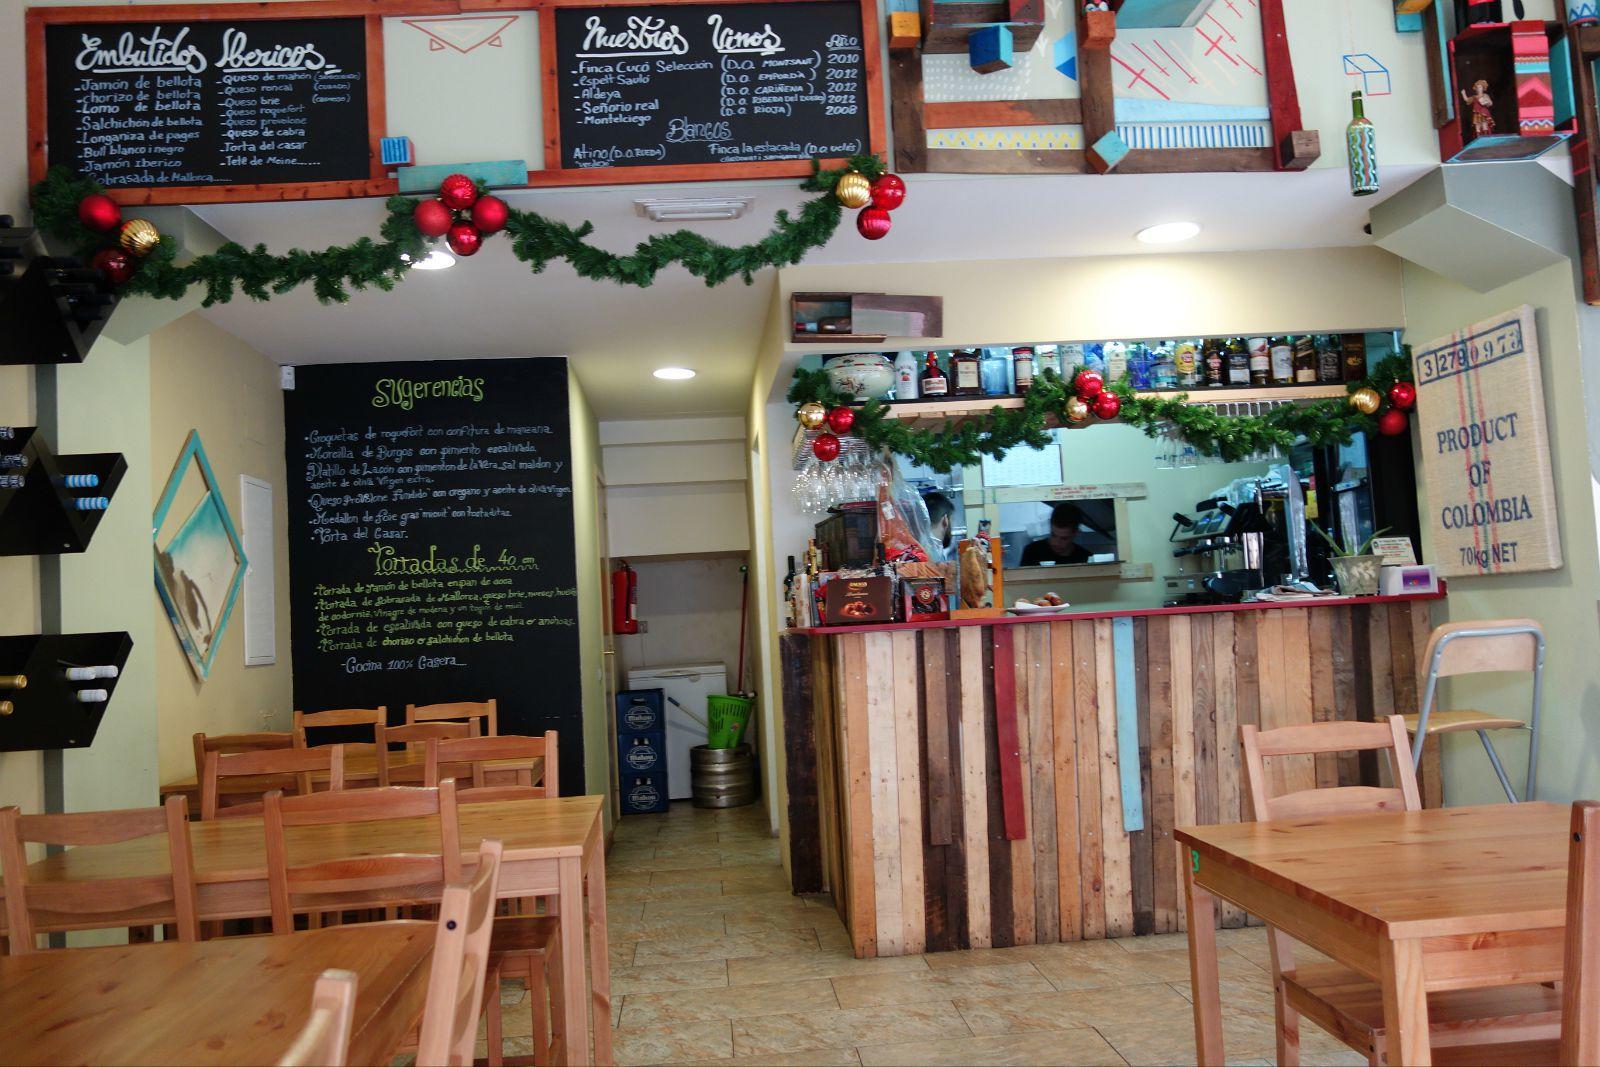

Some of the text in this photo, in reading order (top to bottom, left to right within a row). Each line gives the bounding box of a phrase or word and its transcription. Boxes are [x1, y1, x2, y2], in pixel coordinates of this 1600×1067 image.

[582, 14, 858, 55] Nuestros Vinos Año
[75, 26, 207, 74] Embutidos
[578, 60, 614, 74] Finca
[827, 53, 860, 64] 2010
[222, 75, 259, 86] Queso
[262, 72, 275, 81] de
[825, 68, 858, 79] 2012
[135, 75, 150, 89] de
[156, 75, 202, 88] bellota
[261, 83, 294, 92] roncal
[136, 90, 149, 101] de
[156, 89, 201, 100] bellota
[581, 88, 622, 103] Aldeya
[827, 82, 858, 93] 2012
[82, 100, 201, 114] Lomo de bellota
[225, 96, 280, 109] Queso brie
[635, 98, 660, 111] real
[827, 94, 857, 104] 2012
[825, 105, 858, 116] 2008
[151, 116, 164, 127] de
[167, 116, 203, 127] bellota
[82, 131, 145, 146] Longaniza
[149, 130, 164, 141] de
[262, 127, 275, 137] de
[277, 127, 306, 137] cabra
[83, 146, 106, 158] Bull
[109, 144, 146, 156] blanco
[154, 146, 185, 156] negro
[224, 141, 308, 152] Torta del casar
[708, 142, 740, 155] Finca
[742, 142, 753, 153] la
[250, 156, 263, 166] de
[364, 425, 377, 440] de
[427, 428, 444, 436] con
[494, 422, 505, 435] de
[1437, 412, 1518, 454] PRODUCT
[361, 444, 374, 458] de
[376, 444, 414, 463] Burgos
[420, 447, 437, 456] con
[349, 463, 360, 476] de
[397, 466, 413, 474] con
[457, 458, 468, 470] de
[1469, 460, 1491, 488] OF
[340, 477, 350, 488] de
[432, 490, 447, 498] con
[517, 484, 527, 494] de
[362, 510, 374, 522] de
[451, 510, 466, 518] con
[1442, 494, 1533, 530] COLOMBIA
[353, 526, 369, 539] del
[368, 541, 459, 573] Torradas
[465, 544, 486, 570] de
[498, 548, 517, 566] 40
[1492, 542, 1518, 564] NET
[354, 582, 365, 593] de
[398, 580, 409, 591] de
[411, 578, 444, 589] bellota
[480, 577, 491, 586] de
[361, 596, 373, 607] de
[426, 593, 436, 603] de
[318, 611, 329, 622] de
[366, 621, 378, 633] de
[487, 615, 498, 627] de
[367, 636, 378, 648] de
[473, 632, 483, 643] de
[485, 631, 514, 642] bellota
